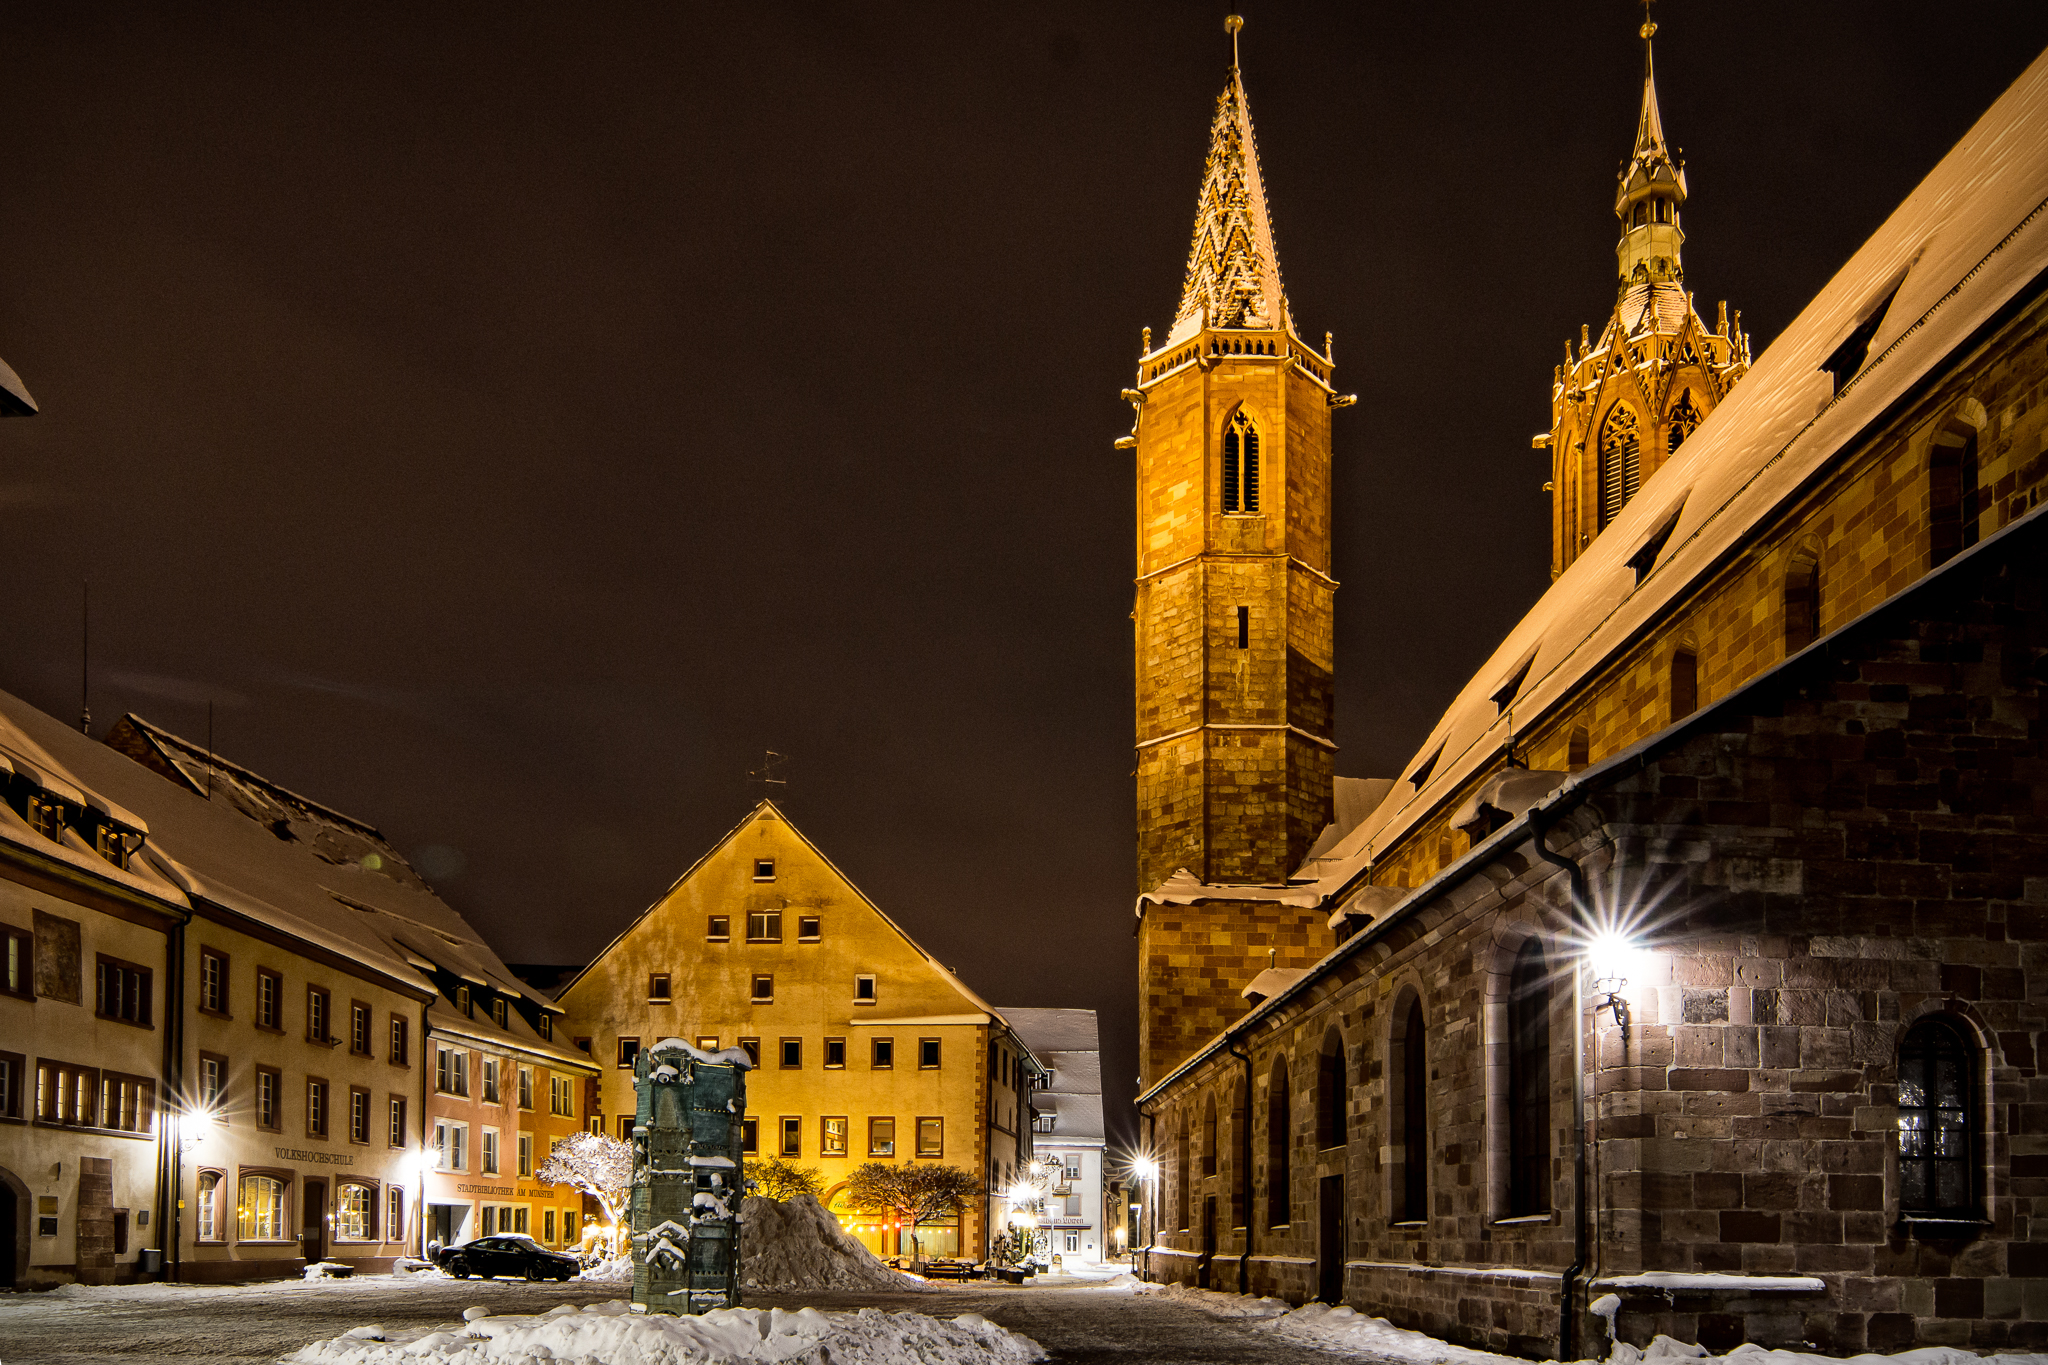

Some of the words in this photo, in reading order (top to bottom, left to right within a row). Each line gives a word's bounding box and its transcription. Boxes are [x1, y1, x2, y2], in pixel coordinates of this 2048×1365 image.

[275, 1147, 354, 1166] VOLKSHOCHSCHULE
[457, 1183, 514, 1196] STADTBIBLIOTHEK
[517, 1188, 526, 1197] AM
